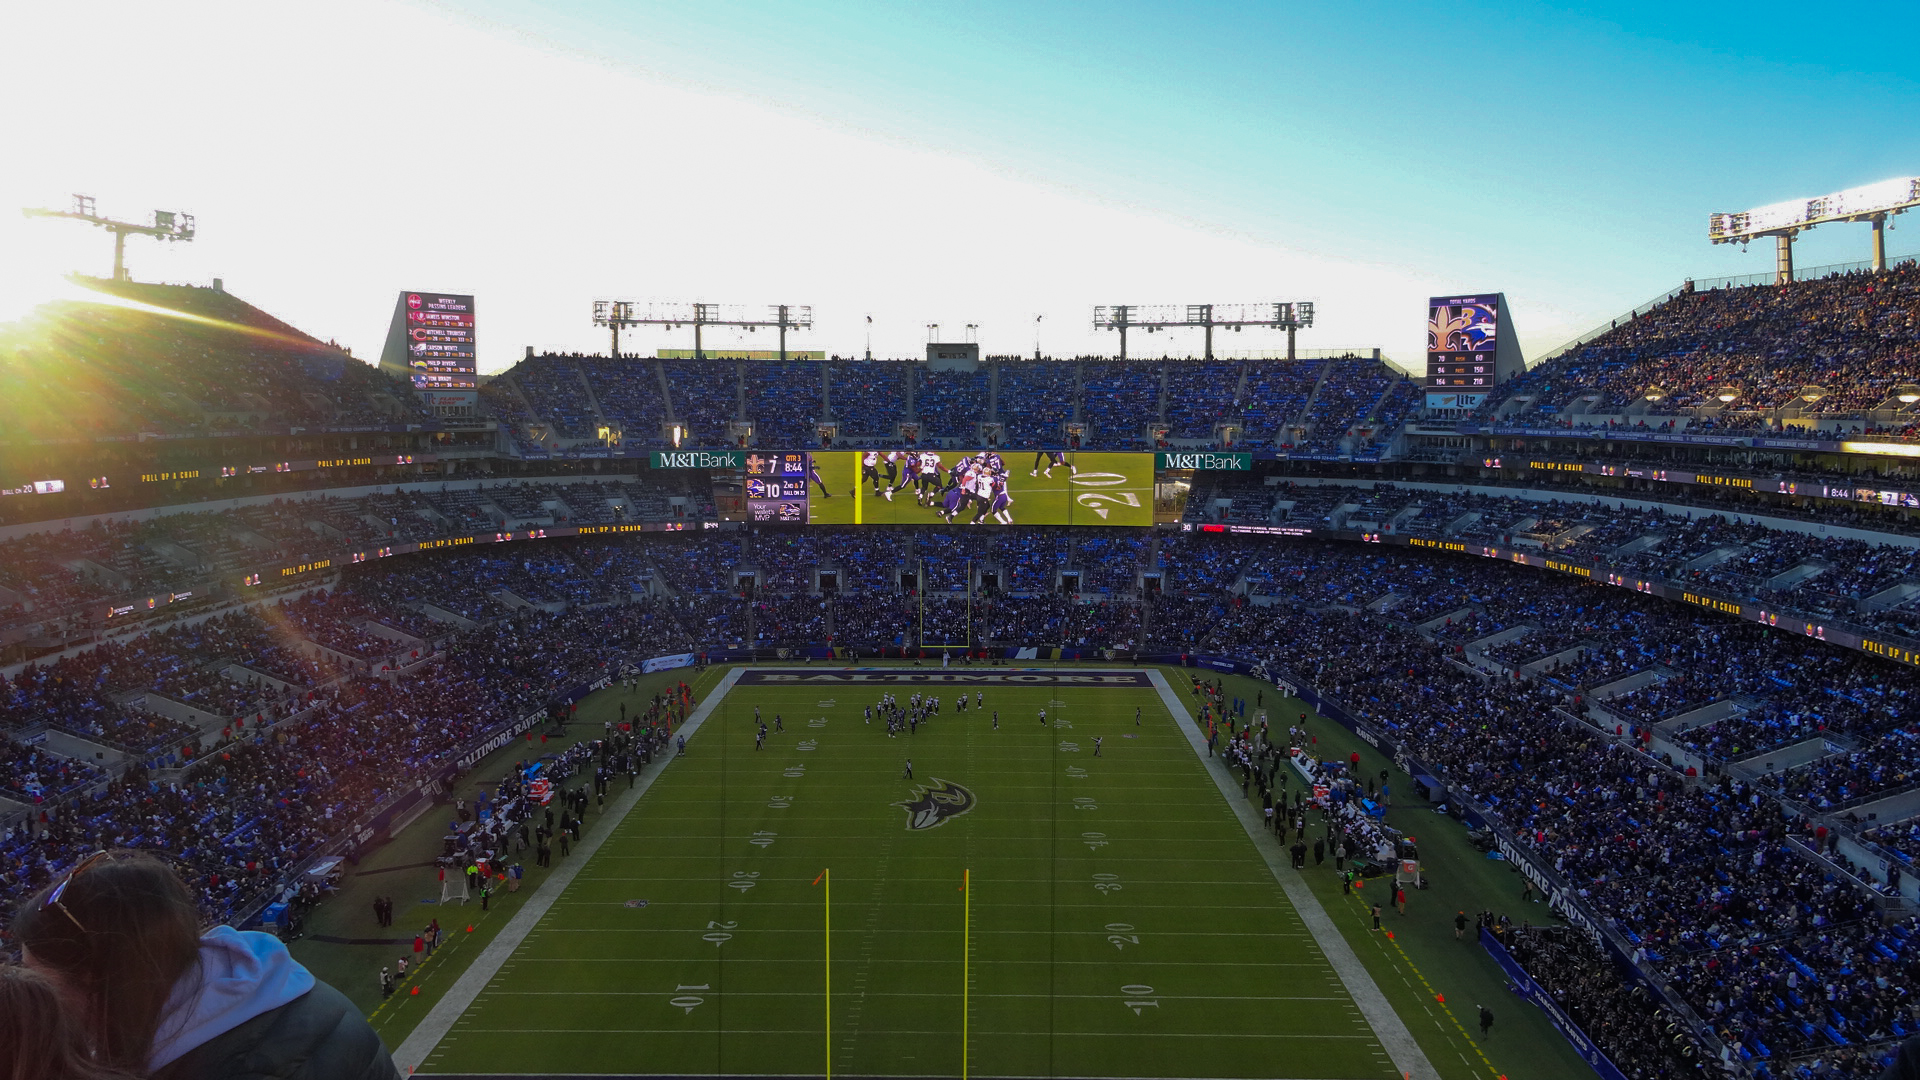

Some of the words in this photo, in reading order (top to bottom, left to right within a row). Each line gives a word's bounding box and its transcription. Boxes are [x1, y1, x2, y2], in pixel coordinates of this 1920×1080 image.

[1456, 394, 1476, 408] Lite
[318, 460, 333, 468] PULL
[354, 458, 371, 466] CHAIR
[660, 453, 699, 468] M&T
[700, 452, 736, 468] Bank
[769, 460, 777, 474] 7
[784, 462, 802, 472] 8:44
[925, 458, 935, 468] 63
[1165, 454, 1203, 468] M&T
[1205, 454, 1242, 470] Bank
[1530, 461, 1545, 470] PULL
[1548, 462, 1555, 470] UP
[1564, 463, 1583, 472] CHAIR
[142, 474, 158, 482] PULL
[161, 472, 170, 481] UP
[180, 470, 200, 479] CHAIR
[1696, 474, 1713, 484] PULL
[1715, 476, 1724, 486] UP
[1732, 478, 1752, 488] CHAIR
[23, 484, 32, 493] 20
[766, 484, 780, 498] 10
[783, 480, 794, 488] 2ND
[799, 480, 804, 488] 7
[1831, 488, 1848, 498] 8:44
[1886, 494, 1893, 504] 7
[420, 542, 433, 550] PULL
[455, 536, 474, 544] CHAIR
[1410, 538, 1425, 547] PULL
[1428, 539, 1436, 548] UP
[1445, 542, 1465, 551] CHAIR
[282, 566, 296, 576] PULL
[298, 564, 306, 573] UP
[314, 560, 330, 570] CHAIR
[1546, 560, 1559, 569] PULL
[1560, 562, 1567, 571] UP
[1574, 566, 1590, 577] CHAIR
[1683, 592, 1700, 604] PULL
[1702, 597, 1710, 606] UP
[1720, 602, 1740, 615] CHAIR
[1862, 640, 1883, 655] PULL
[1888, 649, 1900, 659] UP
[1904, 652, 1910, 662] A
[759, 674, 1138, 683] BALTIMORE
[1277, 676, 1298, 698] RAVENS
[457, 728, 513, 770] BALTIMORE
[512, 706, 548, 736] RAVENS
[1355, 726, 1379, 748] RAVENS
[702, 920, 738, 942] 20
[1104, 922, 1140, 944] 20
[670, 983, 710, 1007] 10
[1120, 984, 1160, 1008] 10
[1534, 990, 1565, 1026] MARCHING
[1565, 1022, 1588, 1052] RAVENS
